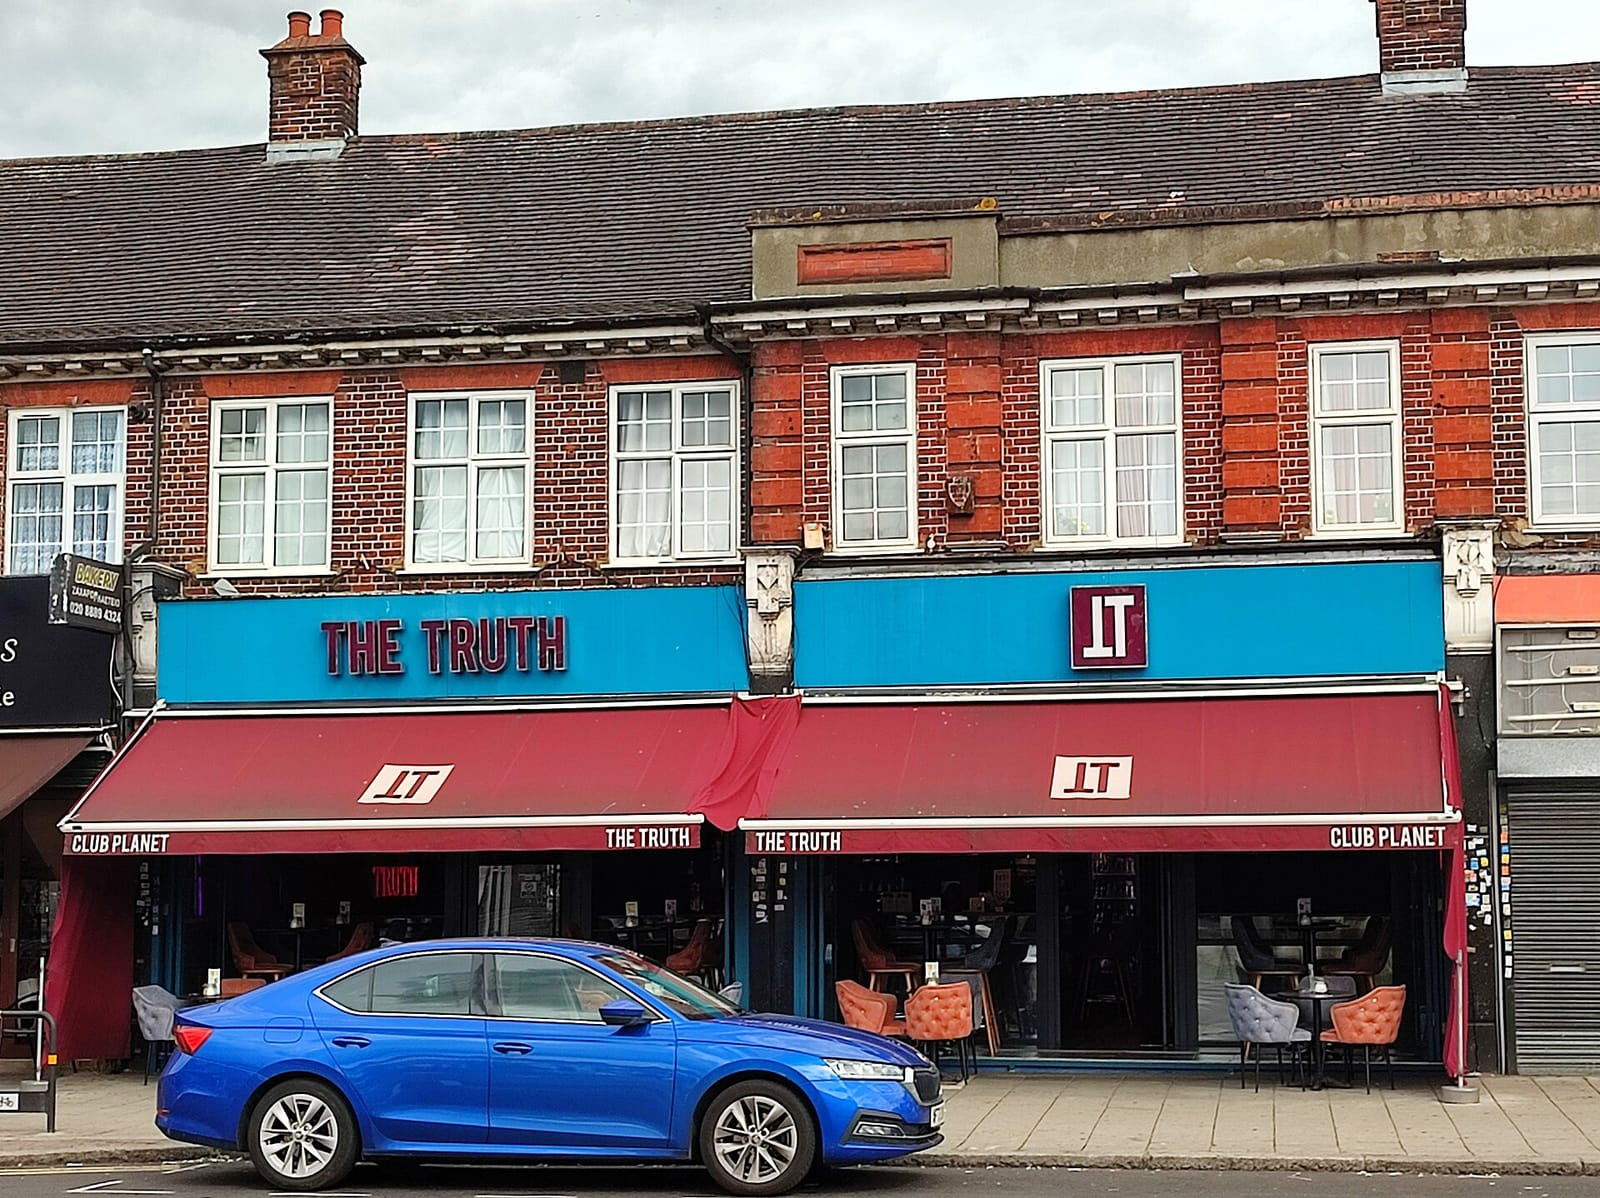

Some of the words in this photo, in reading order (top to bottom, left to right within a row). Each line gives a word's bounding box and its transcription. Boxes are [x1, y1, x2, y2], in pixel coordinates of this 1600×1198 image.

[75, 563, 120, 592] BAKERY
[69, 601, 83, 616] 020
[103, 608, 121, 624] 4324
[320, 618, 405, 675] THE
[419, 615, 567, 674] TRUTH
[72, 834, 110, 853] CLUB
[111, 833, 170, 852] PLANET
[605, 828, 636, 848] THE
[638, 827, 691, 847] TRUTH
[755, 832, 786, 851] THE
[788, 831, 842, 851] TRUTH
[1330, 827, 1375, 847] CLUB
[1378, 826, 1446, 847] PLANET
[372, 866, 419, 896] TRUTH
